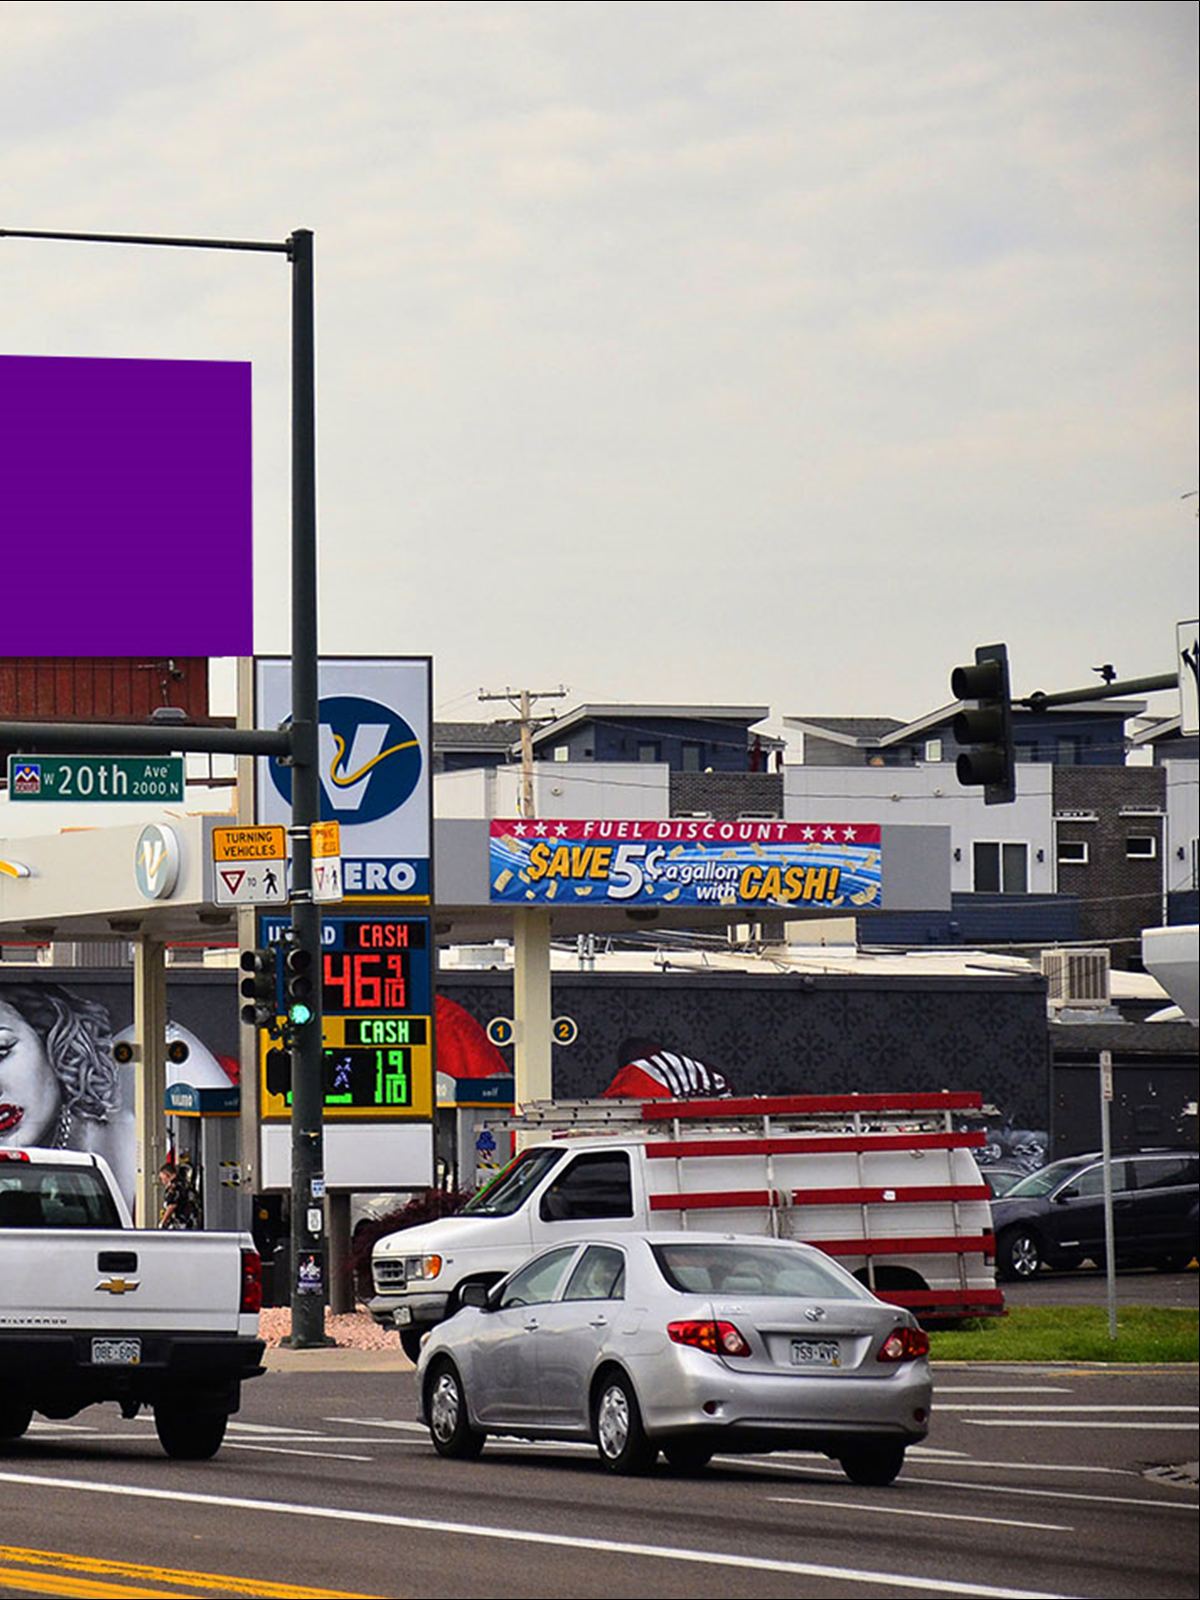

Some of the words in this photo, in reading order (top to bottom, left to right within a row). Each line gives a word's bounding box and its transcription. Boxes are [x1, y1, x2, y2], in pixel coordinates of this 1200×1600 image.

[44, 773, 54, 785] W
[58, 764, 128, 795] 20th
[143, 765, 168, 778] Ave
[132, 782, 167, 795] 2000
[170, 783, 179, 794] N
[583, 821, 644, 838] FUEL
[657, 823, 789, 840] DISCOUNT
[225, 832, 273, 844] TURNING
[223, 845, 276, 858] VEHICLES
[679, 862, 739, 885] gallon
[739, 865, 842, 900] CASH!
[696, 884, 736, 900] with
[359, 924, 409, 948] CASH
[360, 1021, 410, 1044] CASH
[497, 1025, 505, 1038] 1
[559, 1024, 569, 1038] 2
[173, 1047, 183, 1058] 4
[482, 1087, 498, 1097] self
